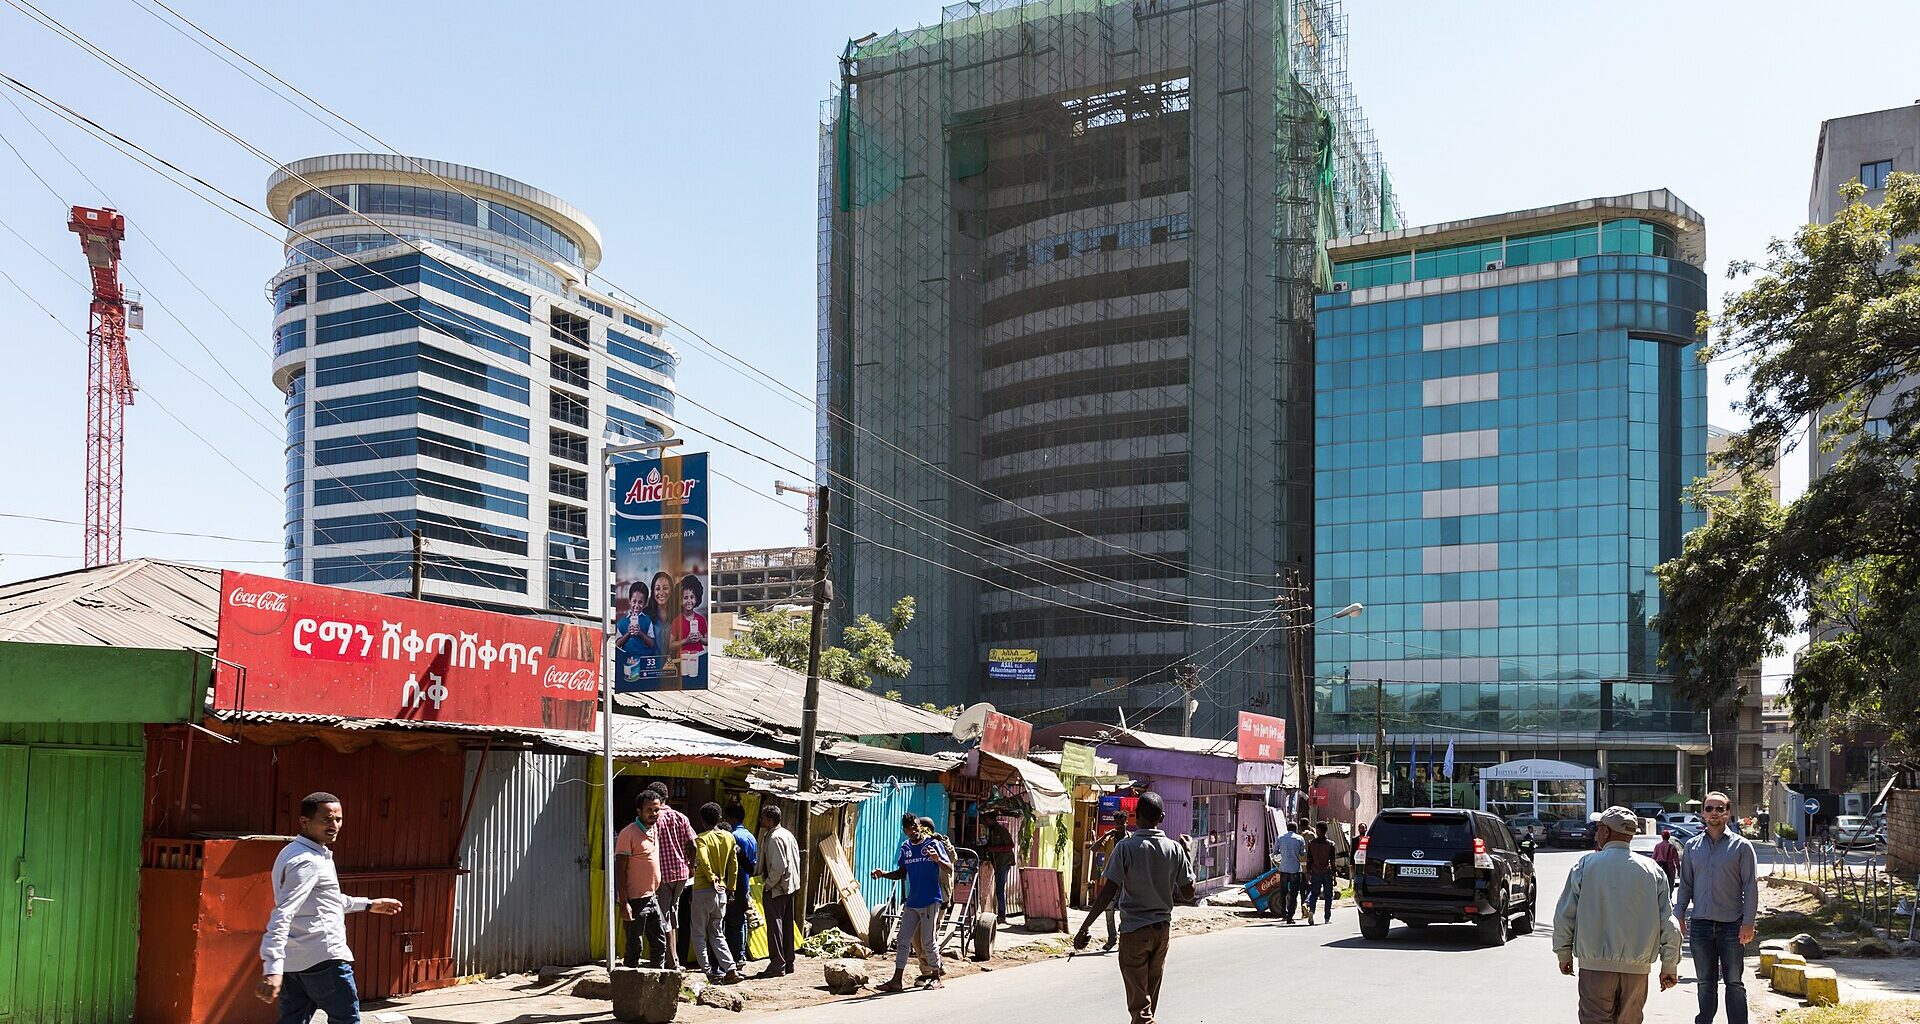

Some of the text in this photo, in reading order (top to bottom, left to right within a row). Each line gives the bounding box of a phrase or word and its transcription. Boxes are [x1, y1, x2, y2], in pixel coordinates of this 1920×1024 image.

[624, 475, 695, 505] Anchor
[229, 586, 288, 612] Coca-Cola
[293, 618, 374, 656] ሮማን
[646, 658, 656, 666] 33
[402, 671, 449, 710] ሱቅ
[543, 665, 595, 692] Coca-Cola
